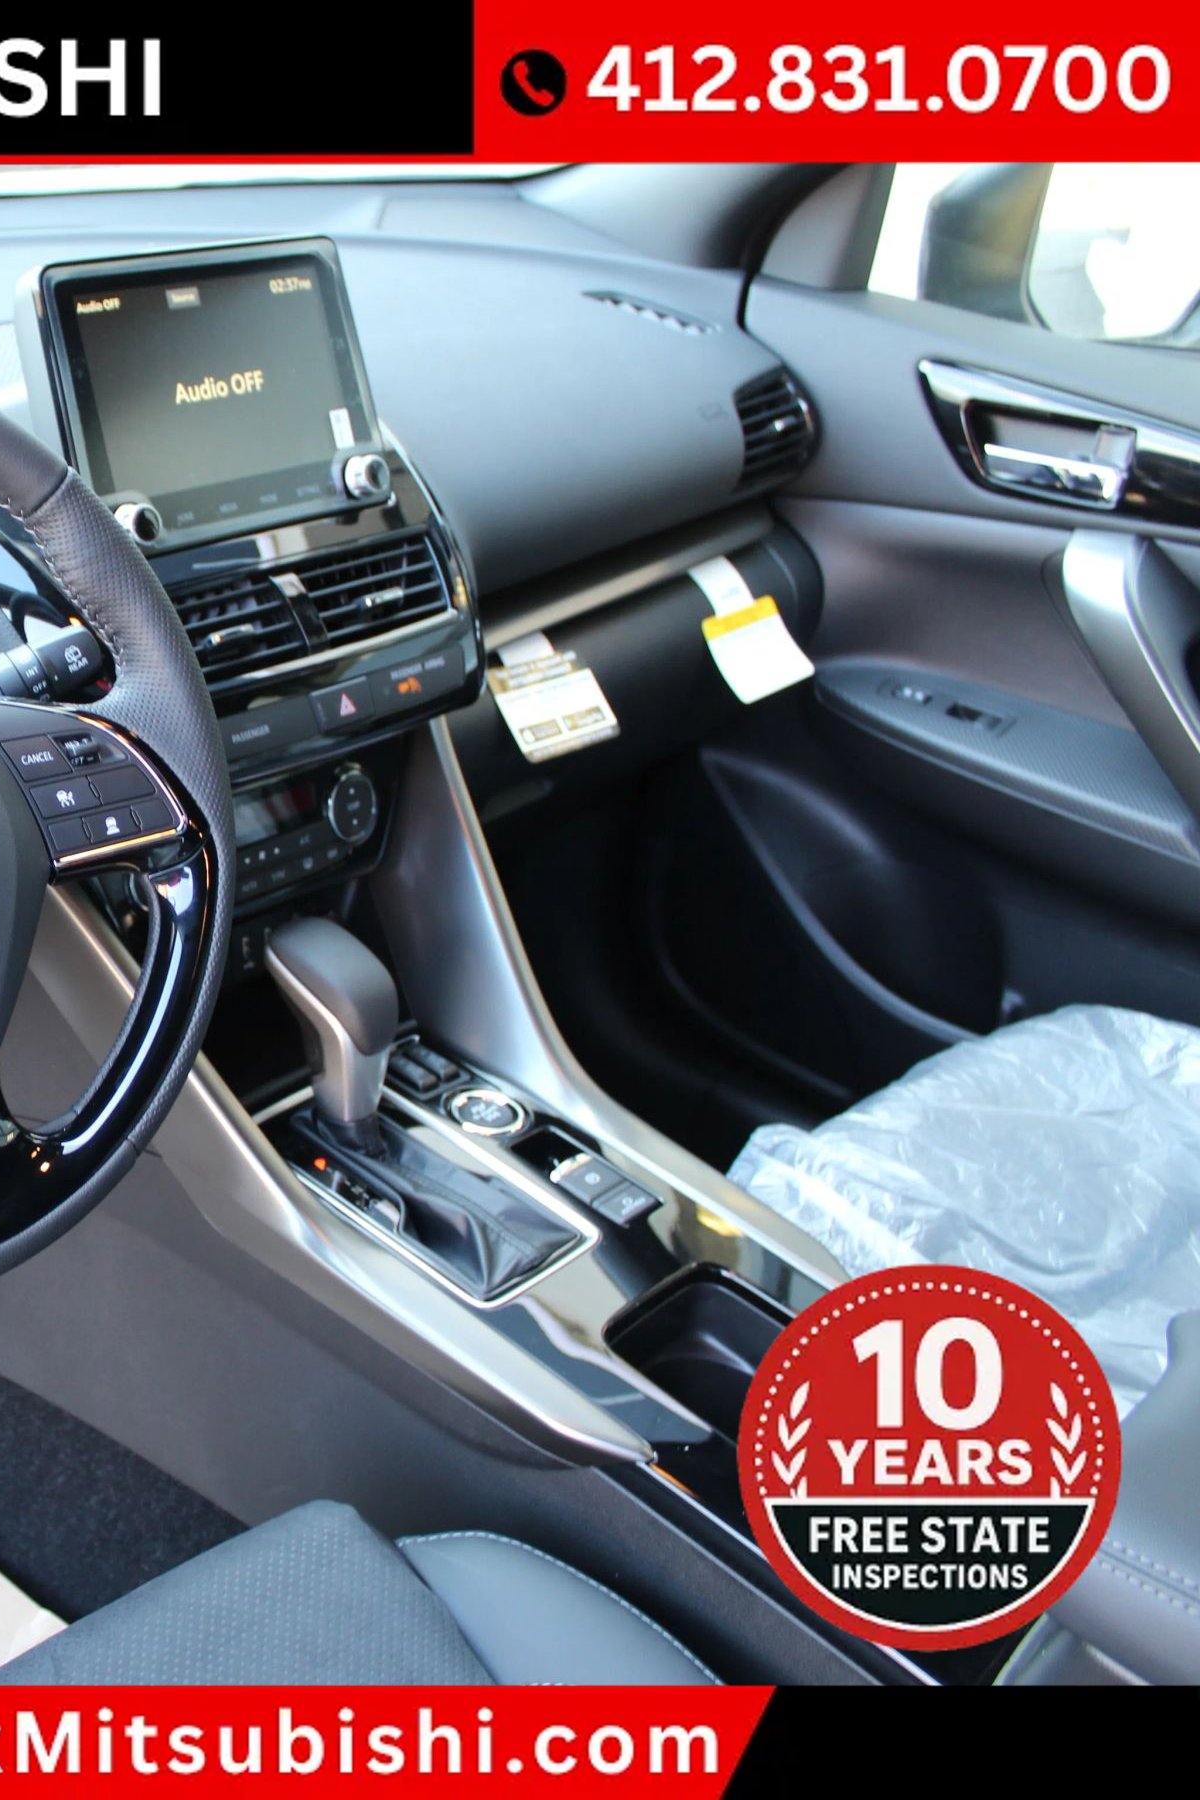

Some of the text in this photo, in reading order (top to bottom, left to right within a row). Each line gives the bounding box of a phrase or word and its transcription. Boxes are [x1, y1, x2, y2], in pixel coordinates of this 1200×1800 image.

[77, 297, 121, 314] Audio OFF
[176, 369, 264, 404] Audio OFF
[25, 666, 39, 678] INT
[68, 658, 89, 673] REAR
[32, 681, 47, 694] OFF
[231, 724, 271, 744] PASSENGER
[21, 751, 54, 766] CANCEL
